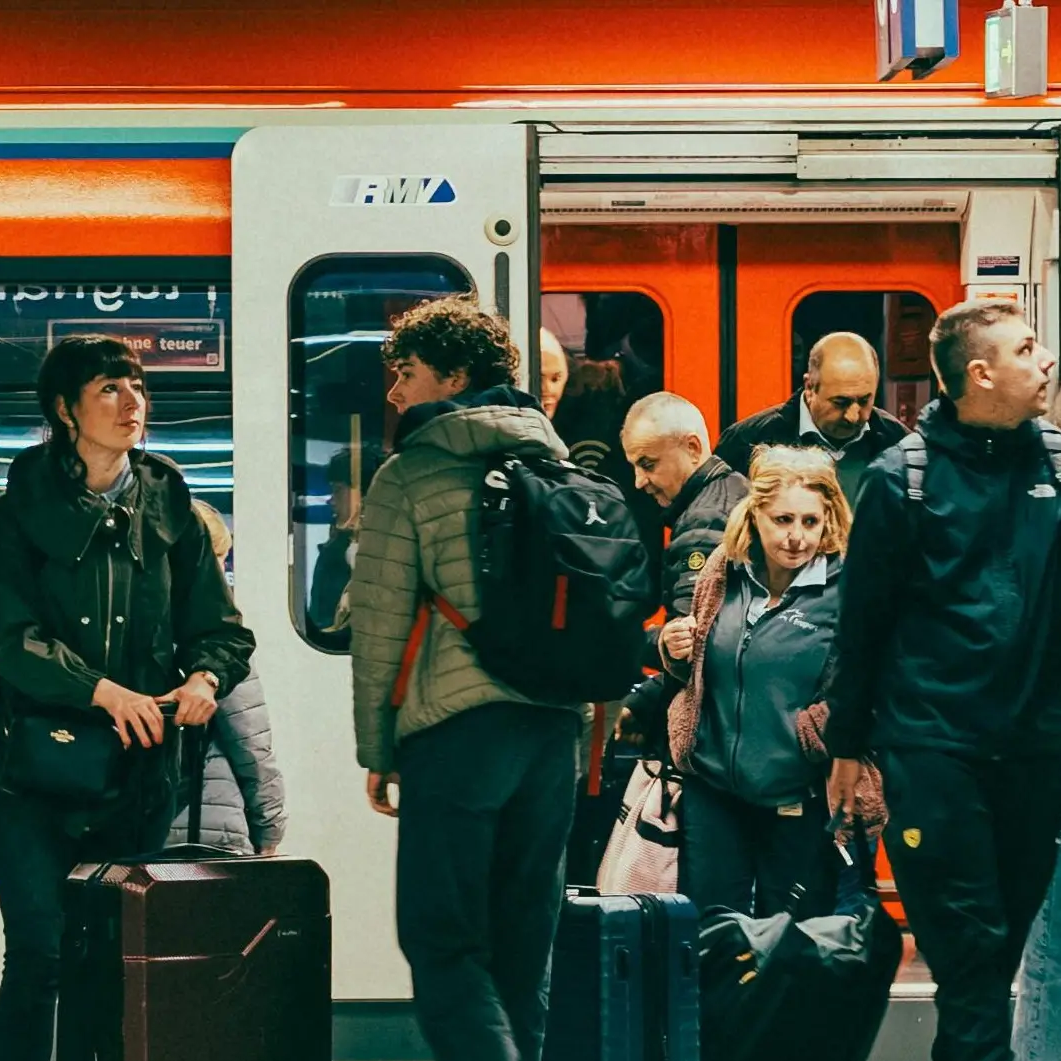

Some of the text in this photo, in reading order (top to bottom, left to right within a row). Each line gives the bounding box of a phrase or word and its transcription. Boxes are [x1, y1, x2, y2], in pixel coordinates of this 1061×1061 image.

[356, 177, 444, 203] RMV
[122, 337, 203, 351] hne teuer
